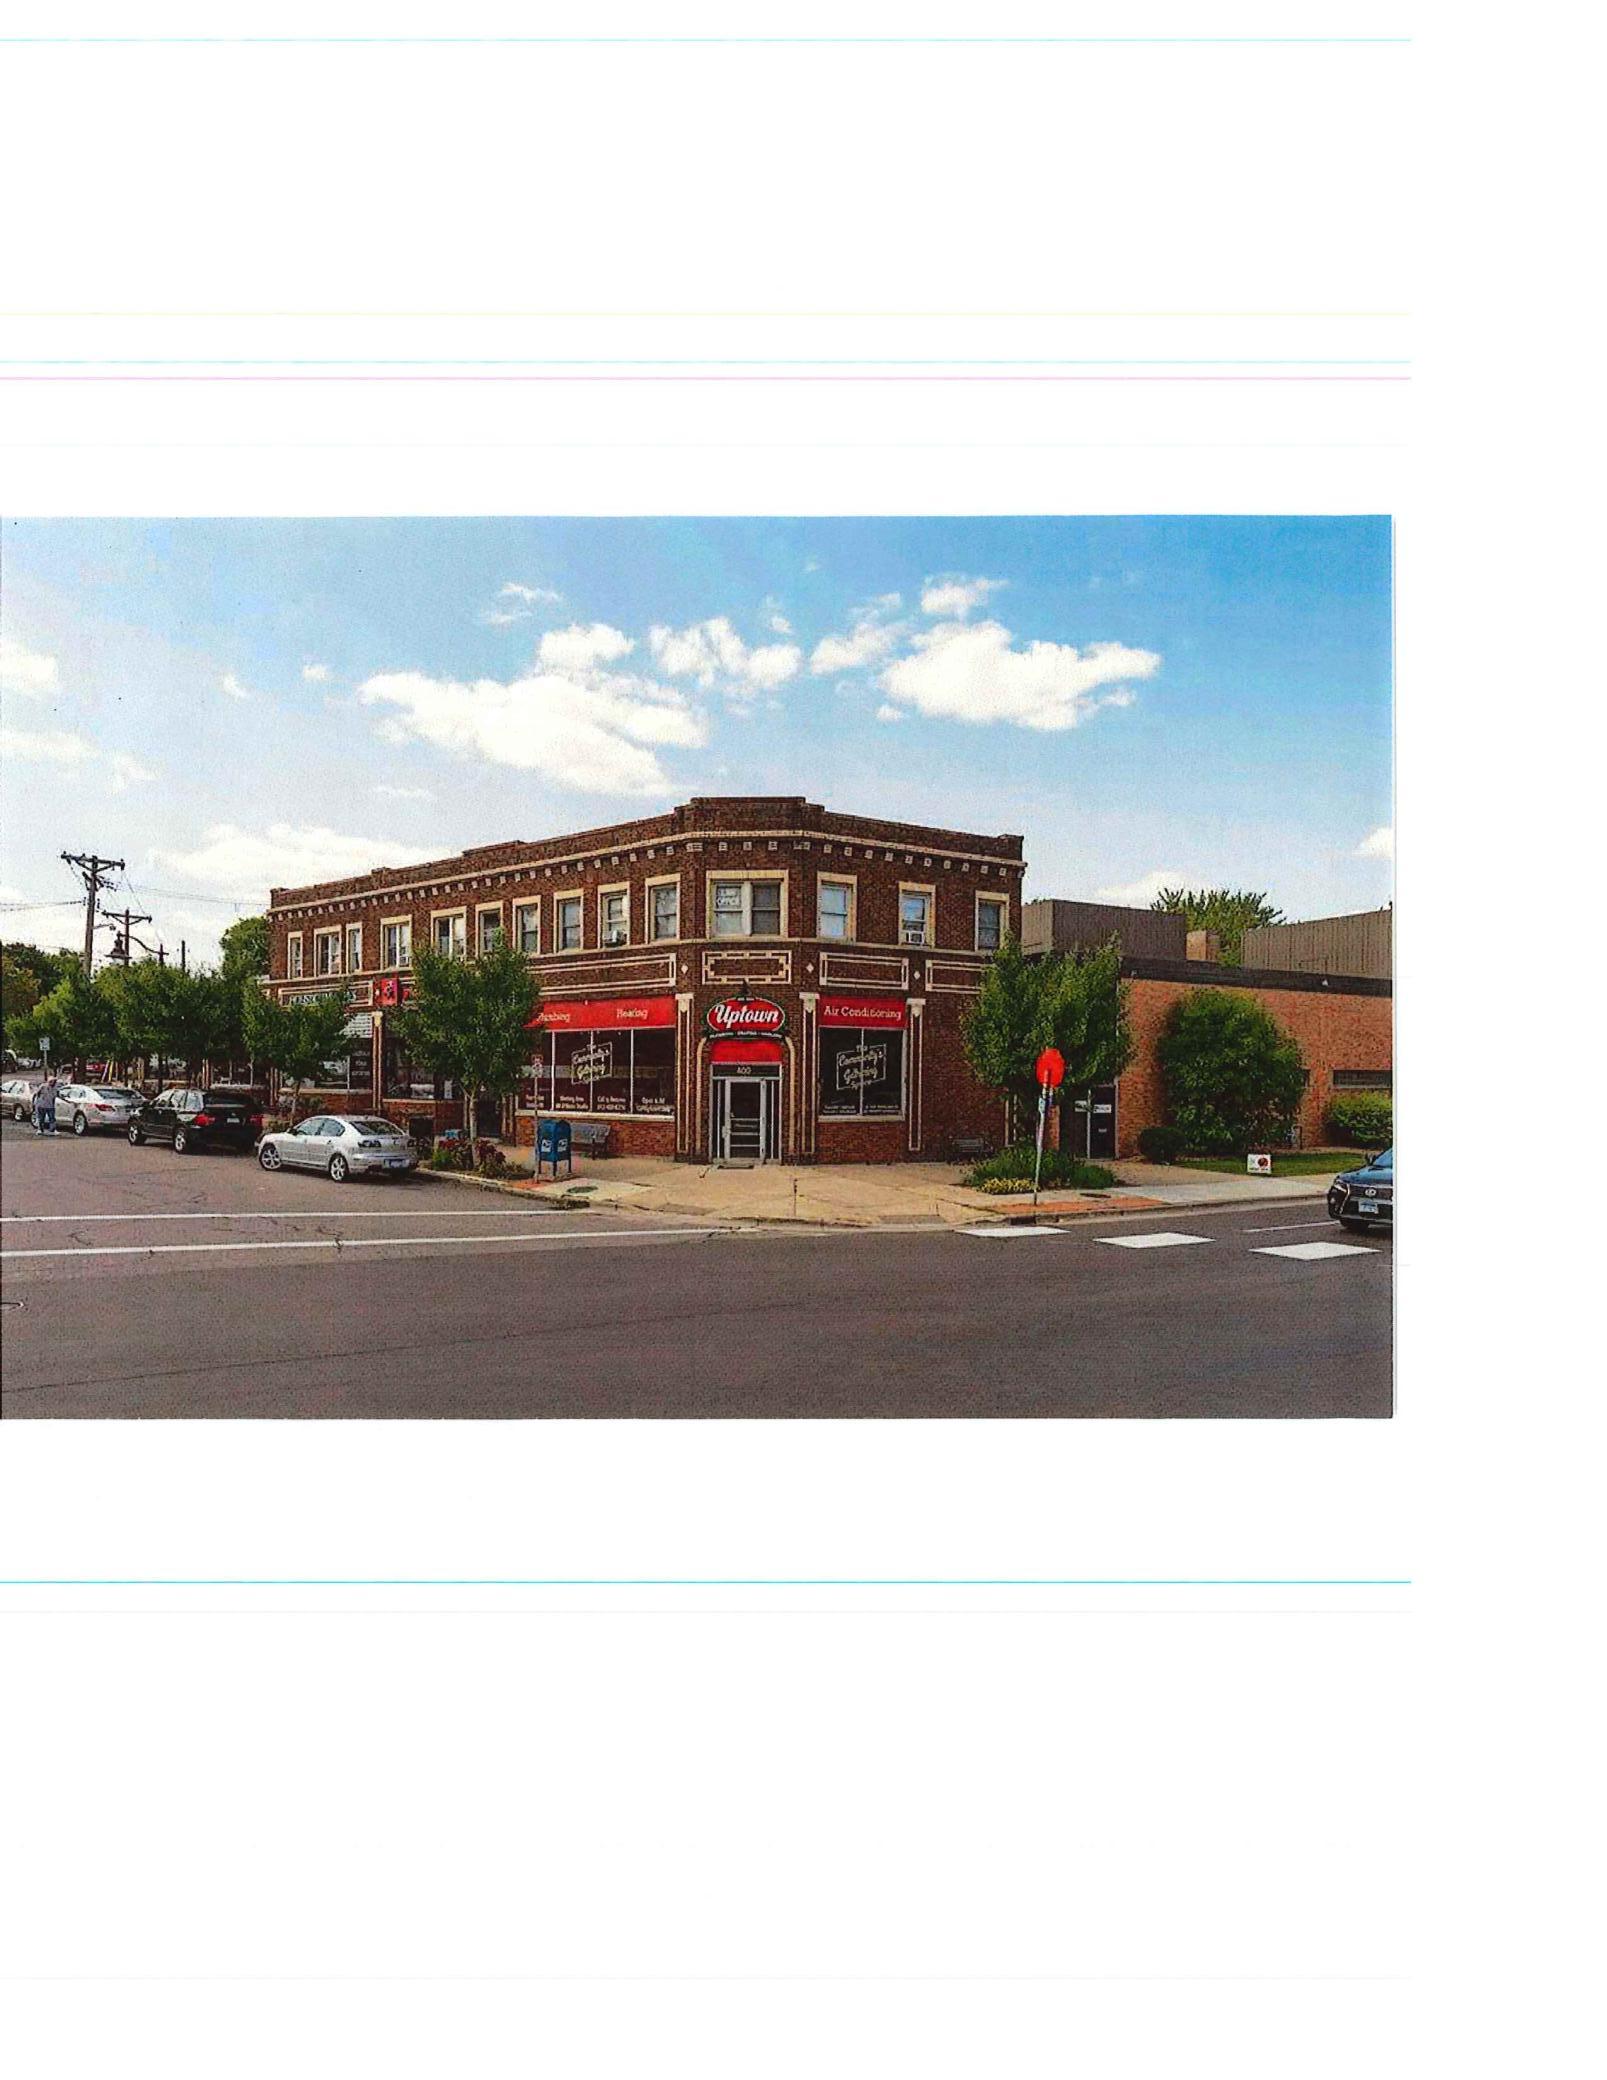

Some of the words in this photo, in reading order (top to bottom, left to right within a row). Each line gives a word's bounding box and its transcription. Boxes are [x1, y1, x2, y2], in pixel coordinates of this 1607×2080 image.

[616, 1007, 649, 1019] Heating
[714, 1004, 779, 1029] Uptown
[823, 1005, 840, 1016] Air
[840, 1005, 902, 1021] Conditioning
